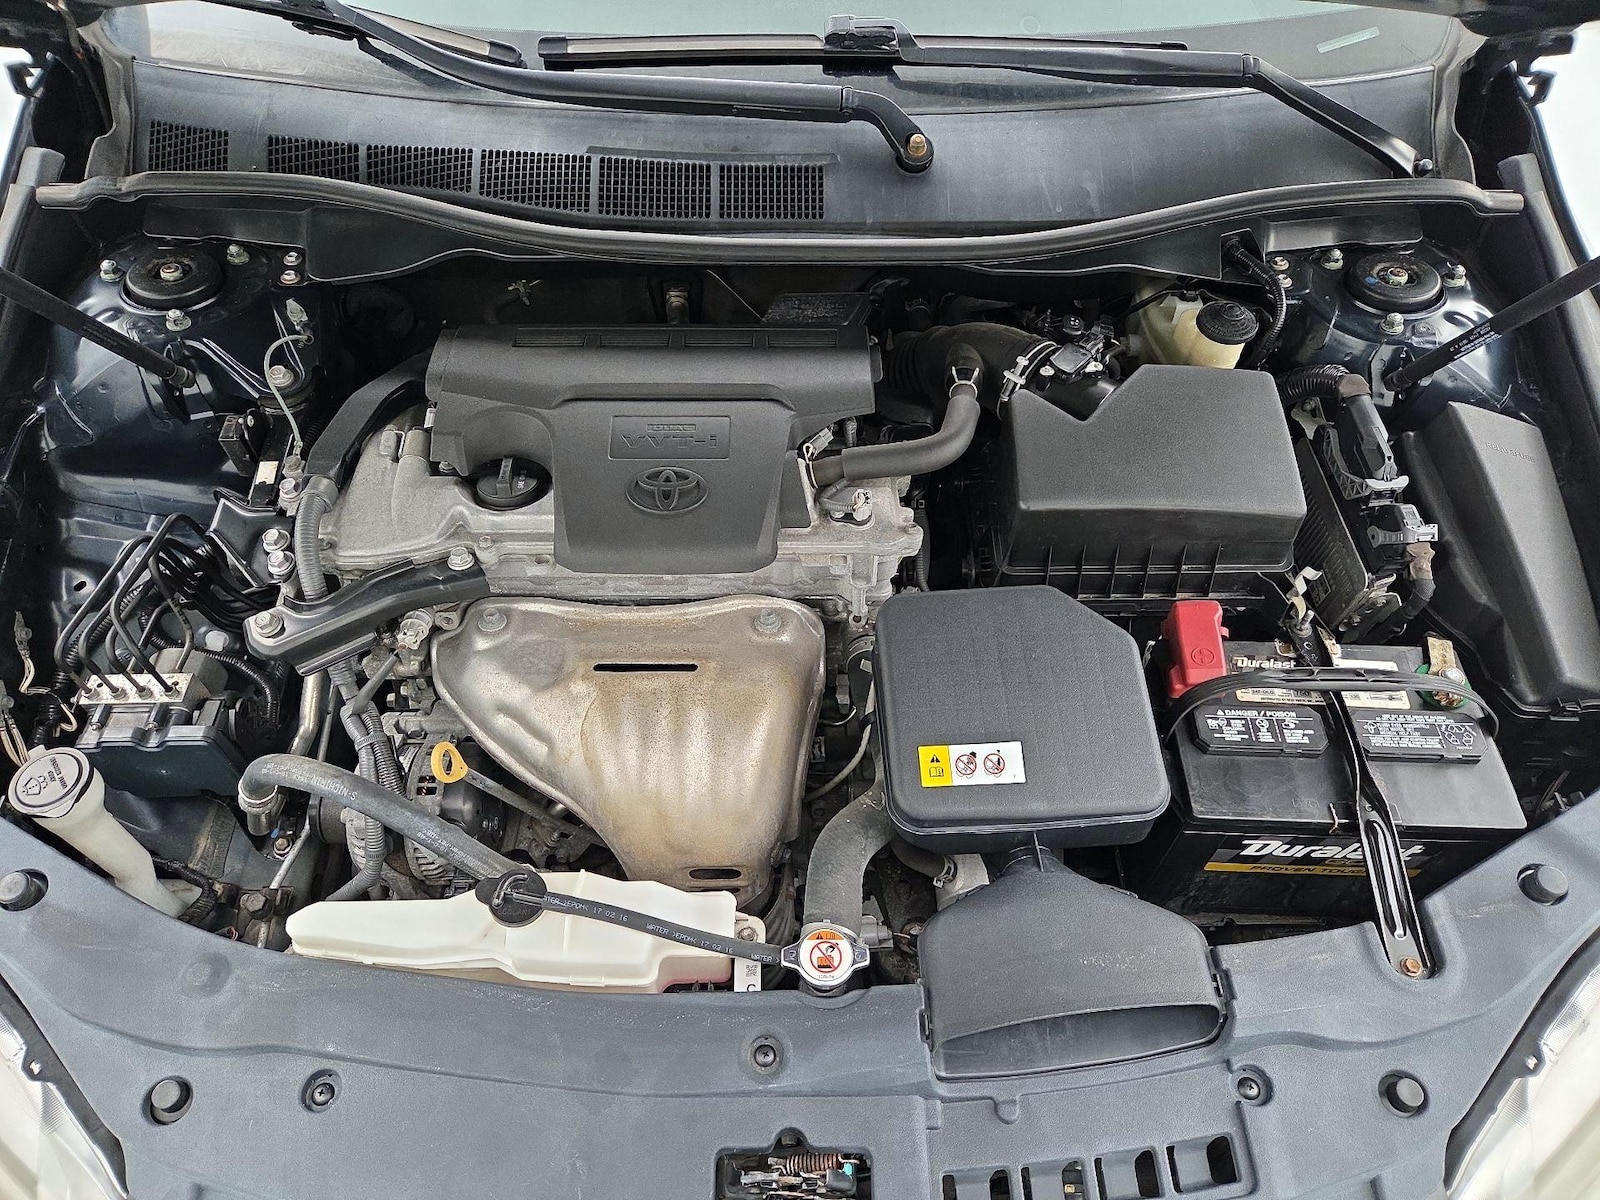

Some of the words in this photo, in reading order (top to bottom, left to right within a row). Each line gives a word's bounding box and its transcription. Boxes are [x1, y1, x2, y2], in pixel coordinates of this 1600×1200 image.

[621, 435, 717, 449] VVT-i
[1233, 656, 1297, 669] Duralast
[1250, 865, 1314, 873] PROVEN
[593, 907, 603, 915] 17
[646, 922, 669, 936] WATER
[751, 953, 773, 963] WATER
